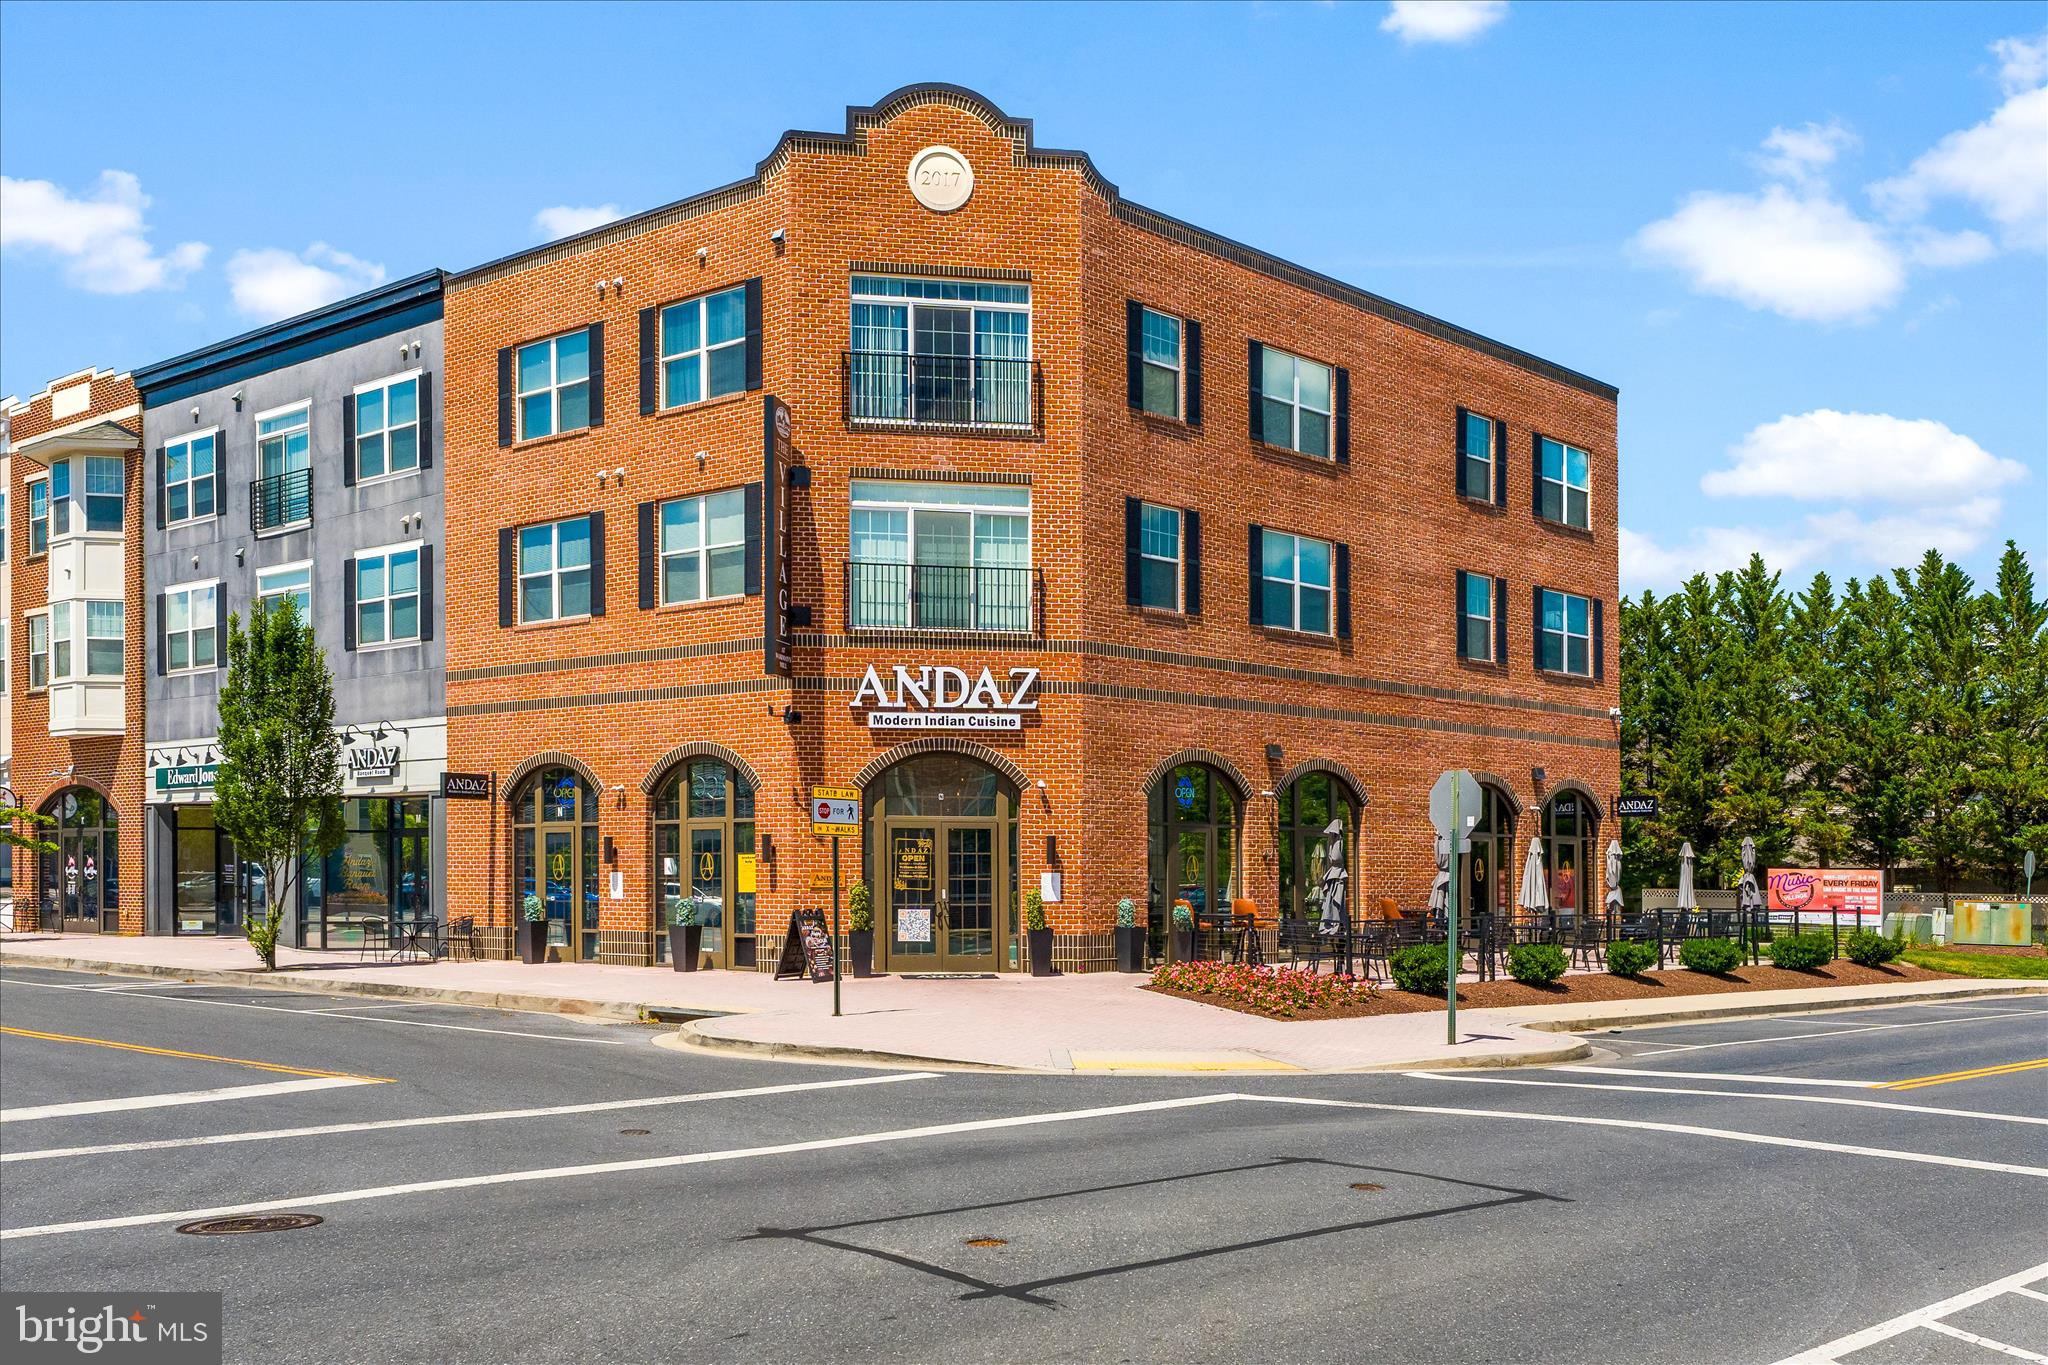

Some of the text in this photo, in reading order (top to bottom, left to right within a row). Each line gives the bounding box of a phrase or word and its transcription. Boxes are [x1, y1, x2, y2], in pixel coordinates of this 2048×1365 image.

[921, 170, 961, 187] 2017
[777, 438, 789, 456] THE
[778, 460, 788, 637] VILLAGE
[849, 663, 1040, 709] ANDAZ
[873, 715, 1016, 727] Modern Indian Cuisine
[347, 747, 398, 769] ANDAZ
[168, 768, 198, 785] Edward
[447, 778, 487, 791] ANDAZ
[1175, 788, 1195, 798] OPEN
[1619, 799, 1654, 811] ANDAZ
[1768, 873, 1821, 892] Music
